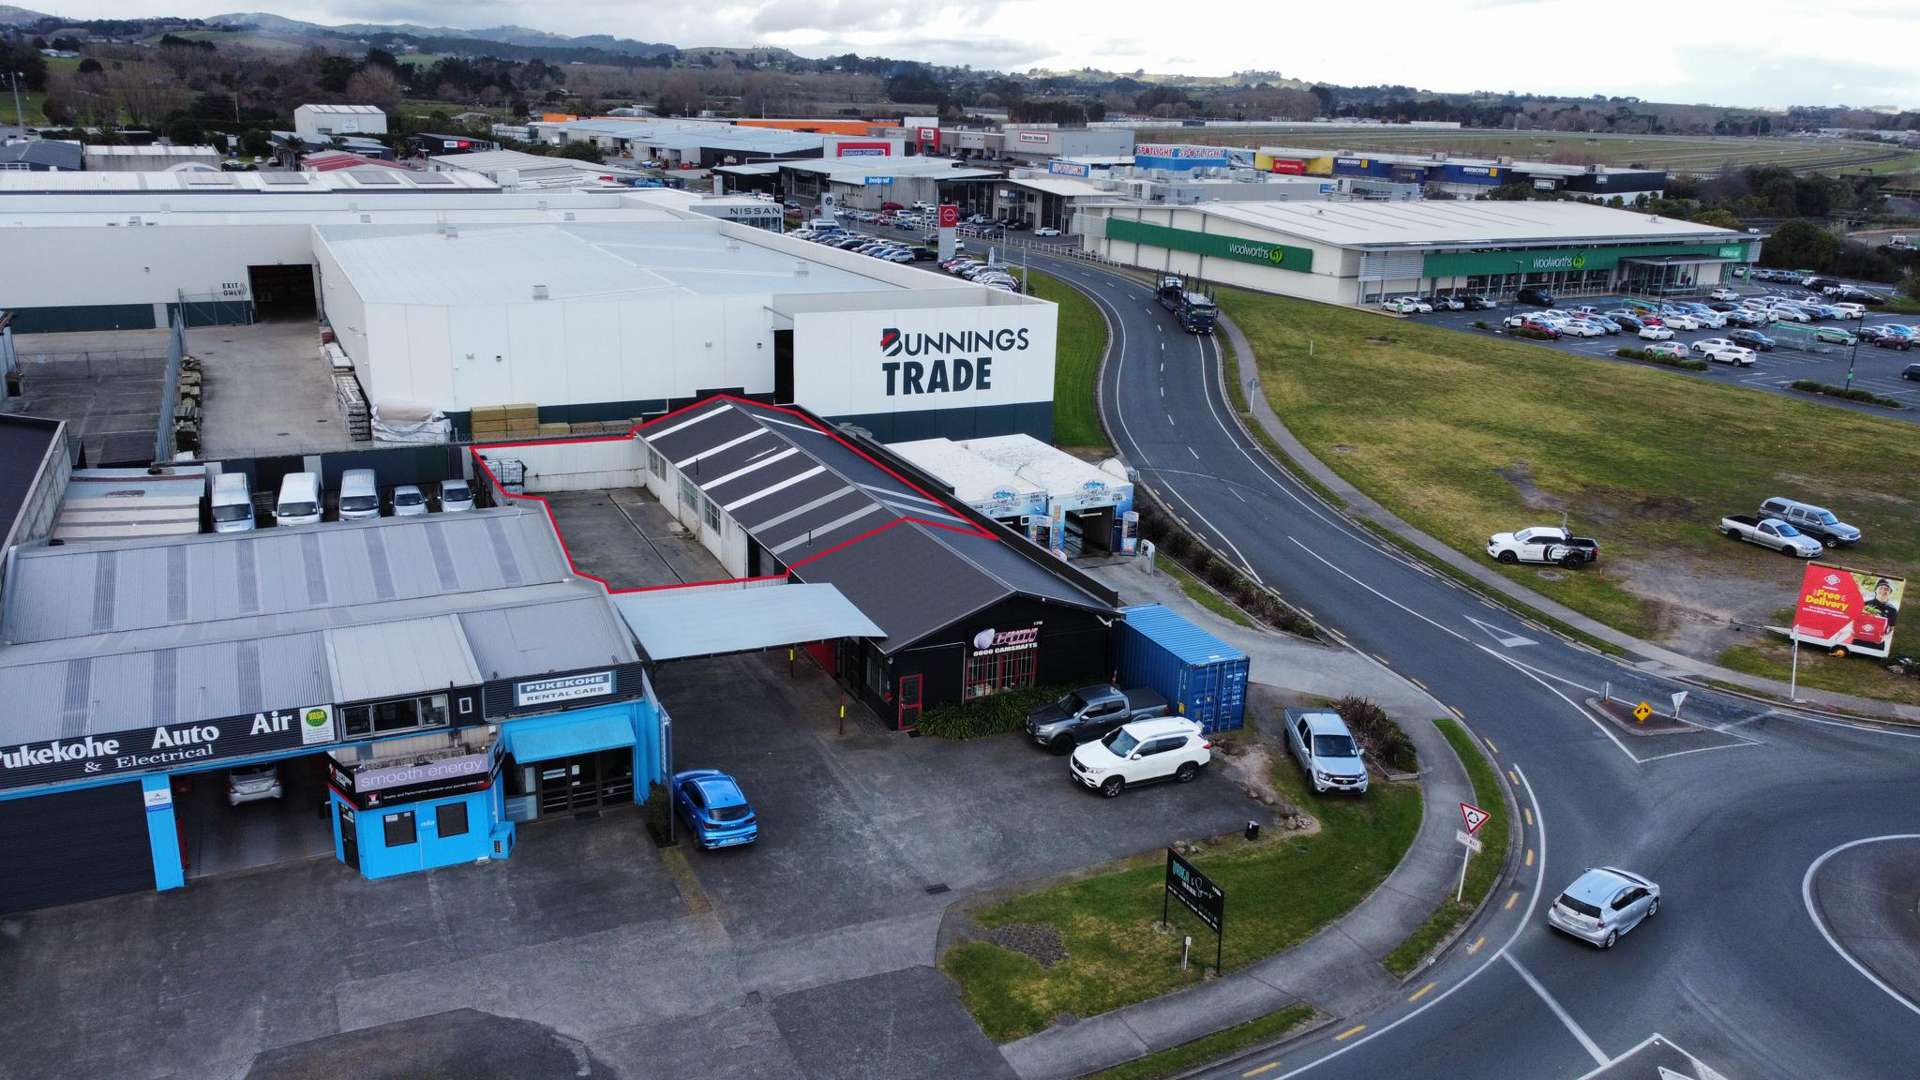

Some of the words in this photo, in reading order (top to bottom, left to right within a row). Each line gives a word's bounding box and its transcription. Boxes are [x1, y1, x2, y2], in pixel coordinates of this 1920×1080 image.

[1136, 146, 1173, 157] SPOTLIGHT
[1182, 148, 1224, 158] SPOTLIGHT
[730, 207, 780, 215] NISSAN
[880, 327, 1029, 357] BUNNINGS
[882, 357, 992, 396] TRADE
[1804, 594, 1849, 612] Delivery
[1816, 588, 1841, 601] Free
[994, 642, 1038, 654] CAMSHAFTS
[526, 676, 604, 692] PUKEKOHE
[526, 690, 572, 701] RENTAL
[574, 686, 605, 696] CARS
[151, 725, 220, 749] Auto
[250, 710, 293, 735] Air
[84, 761, 102, 773] &
[116, 744, 214, 769] Electrical
[360, 766, 424, 788] smooth
[427, 759, 483, 777] energy
